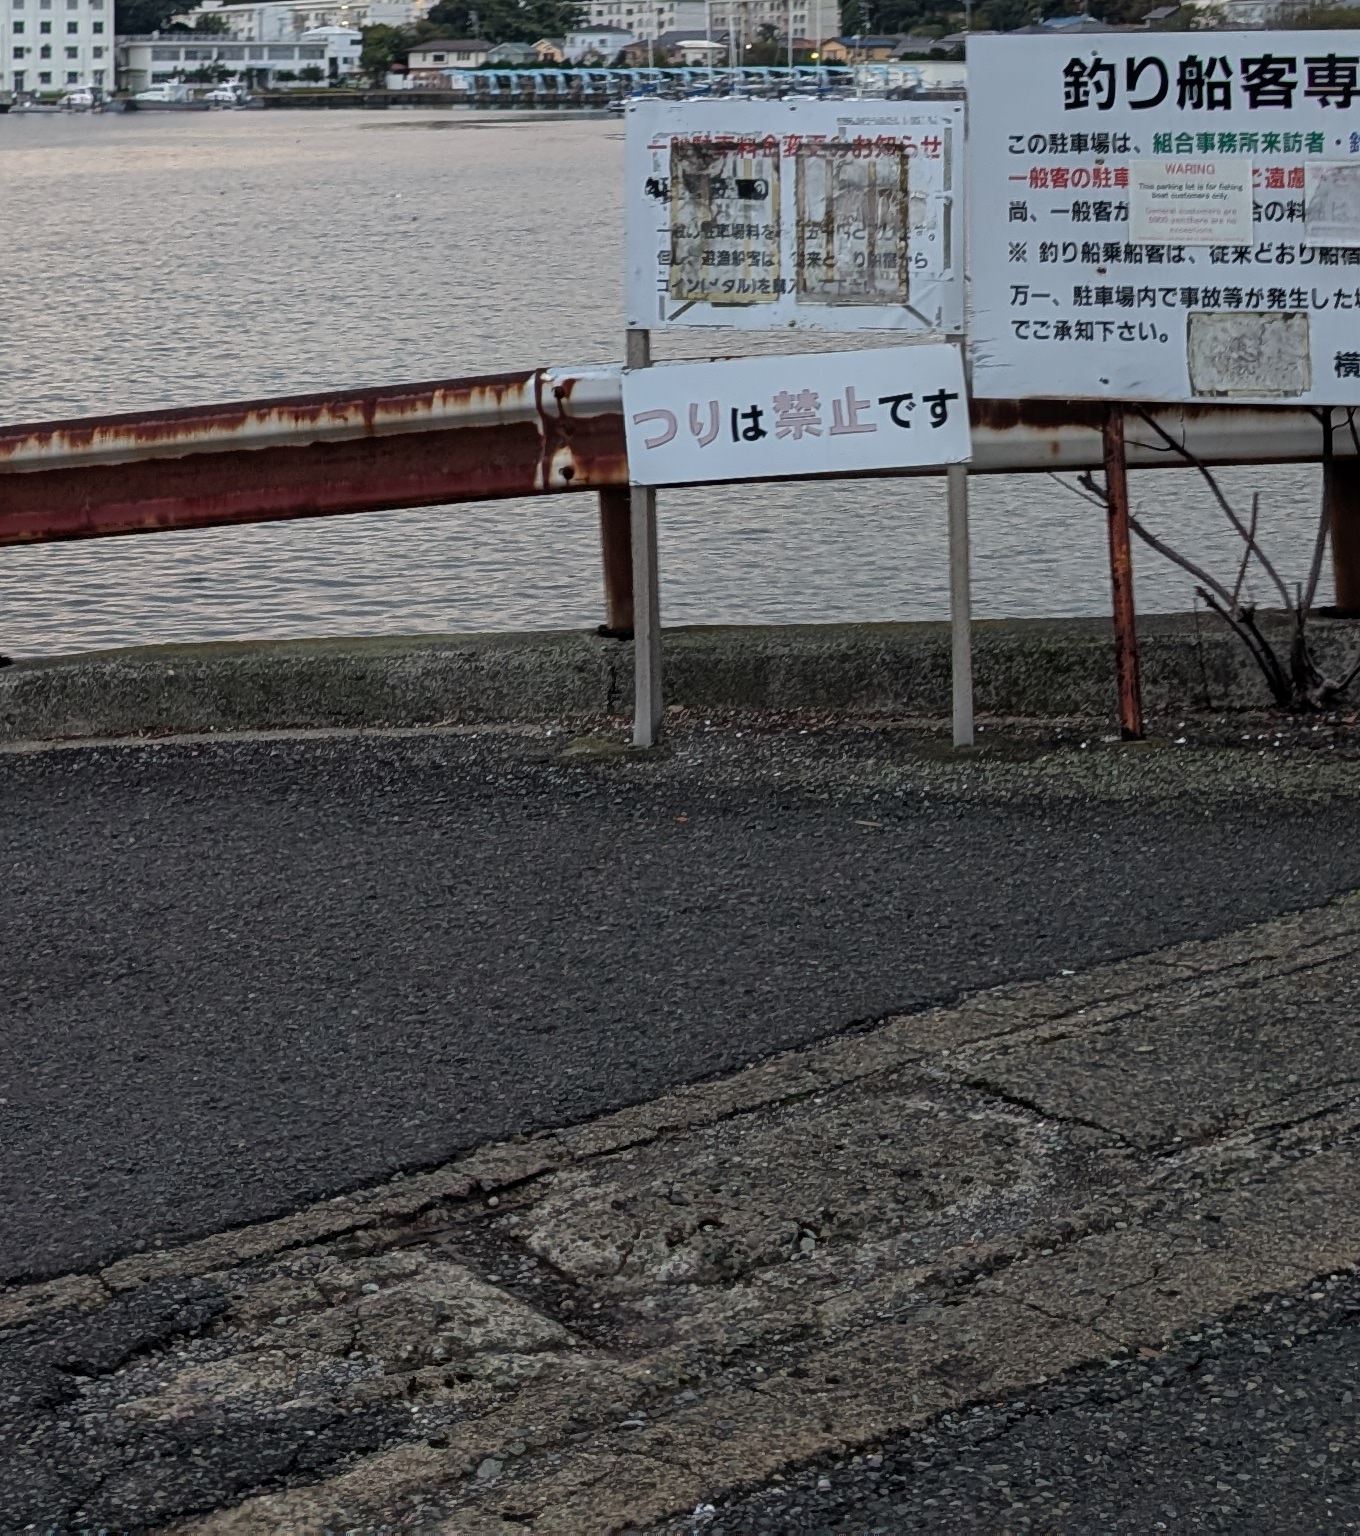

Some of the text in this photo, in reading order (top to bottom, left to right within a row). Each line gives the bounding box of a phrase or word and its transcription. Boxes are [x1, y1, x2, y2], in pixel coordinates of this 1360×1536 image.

[1156, 183, 1183, 192] parking
[1011, 319, 1170, 343] でご承知下さい。
[632, 386, 959, 449] つりは禁止です
